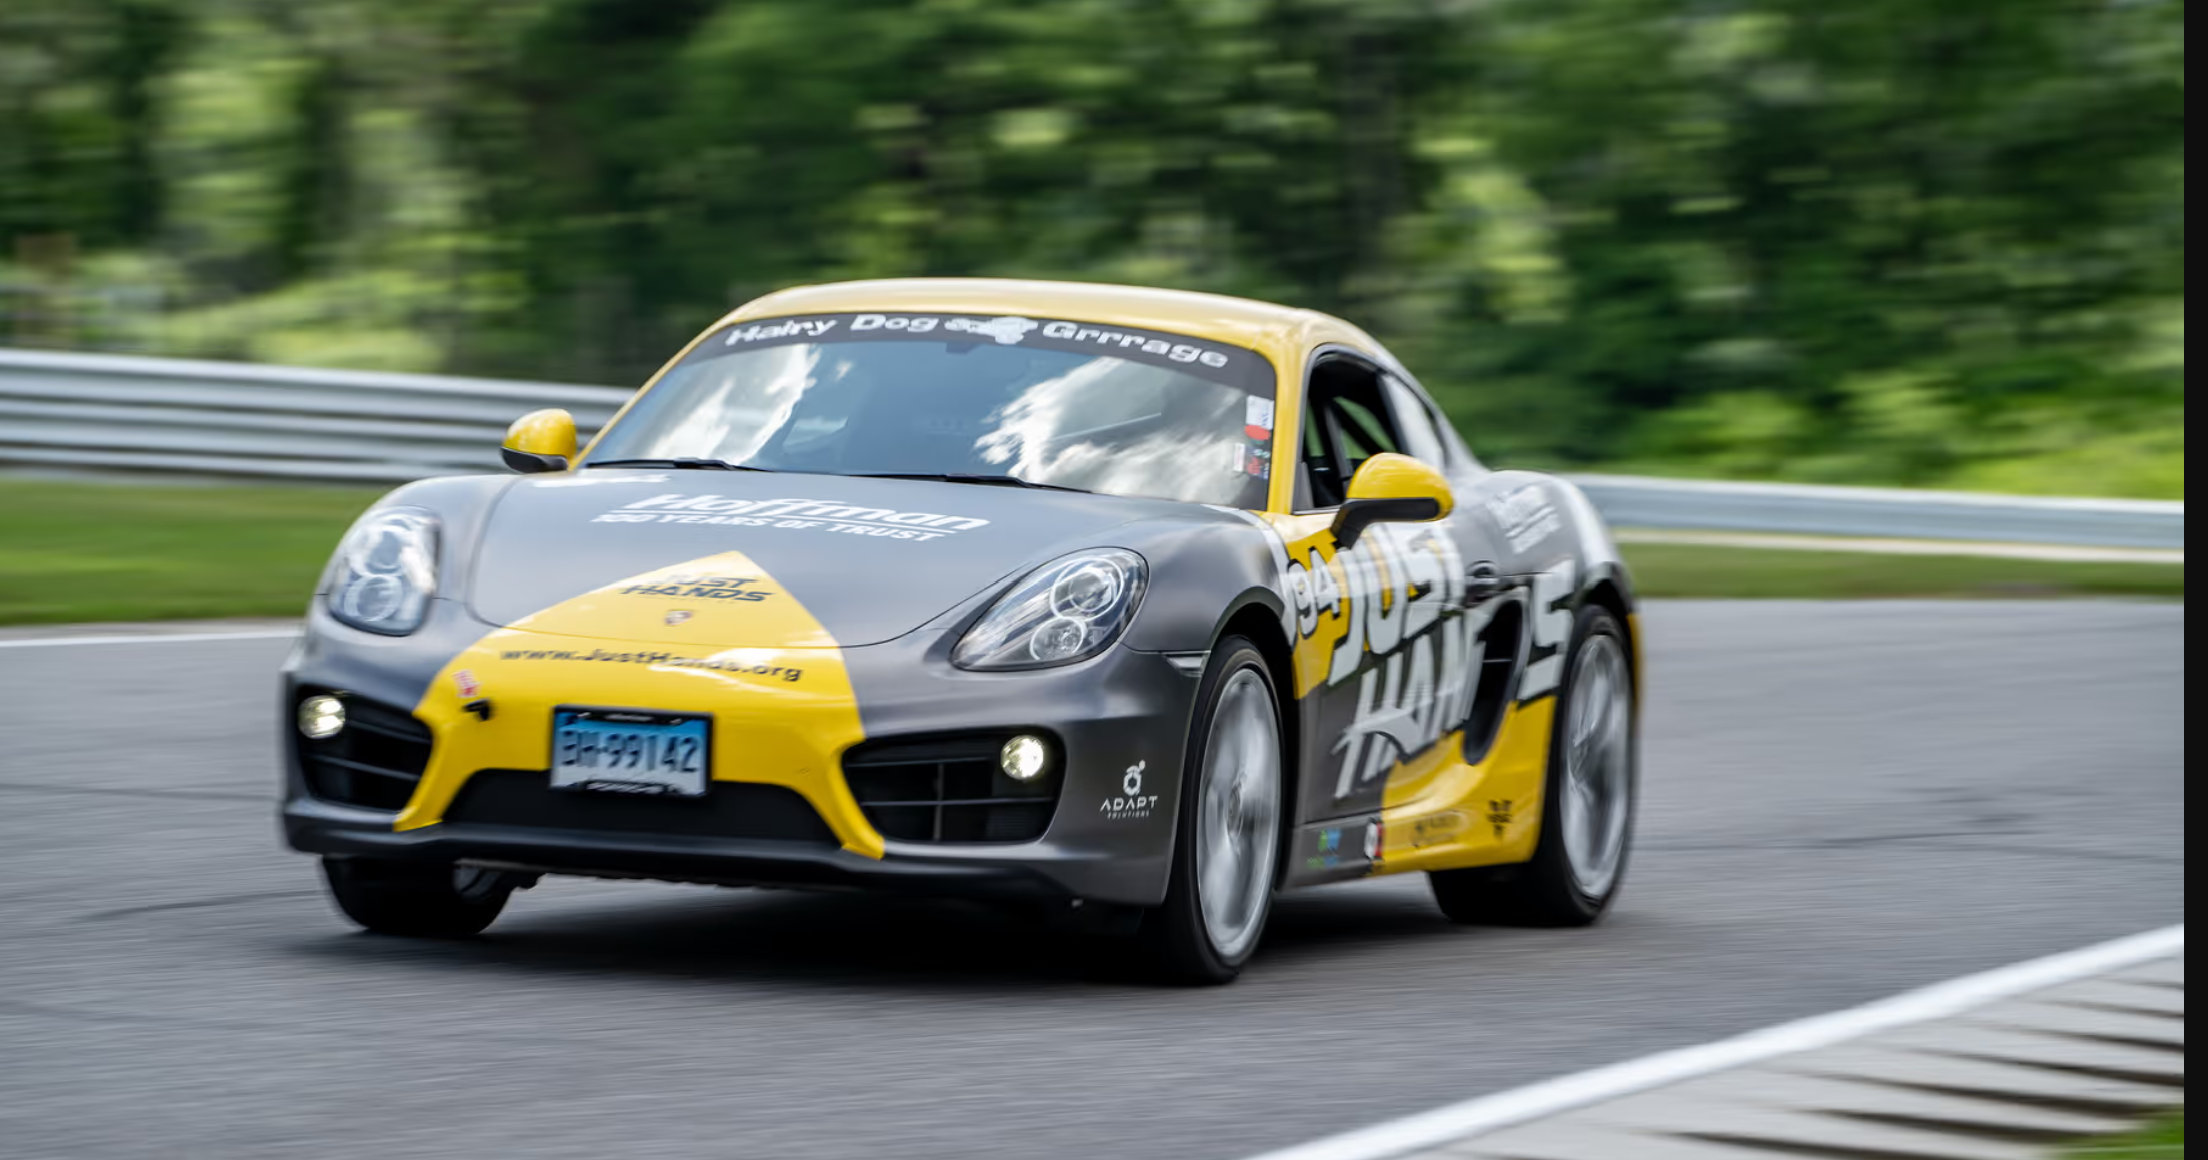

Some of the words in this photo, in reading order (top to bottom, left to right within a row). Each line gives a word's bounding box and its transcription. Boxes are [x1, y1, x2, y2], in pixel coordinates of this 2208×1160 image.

[725, 319, 838, 346] Hairy
[850, 313, 940, 333] Dog
[1042, 321, 1229, 368] Grrrage
[621, 494, 991, 531] Hoffman
[658, 513, 775, 527] YEARS
[781, 519, 827, 530] OF
[825, 523, 946, 542] TRUST
[619, 584, 776, 602] HANDS
[500, 649, 804, 682] www.JustHands.org
[1100, 795, 1158, 812] ADAPT
